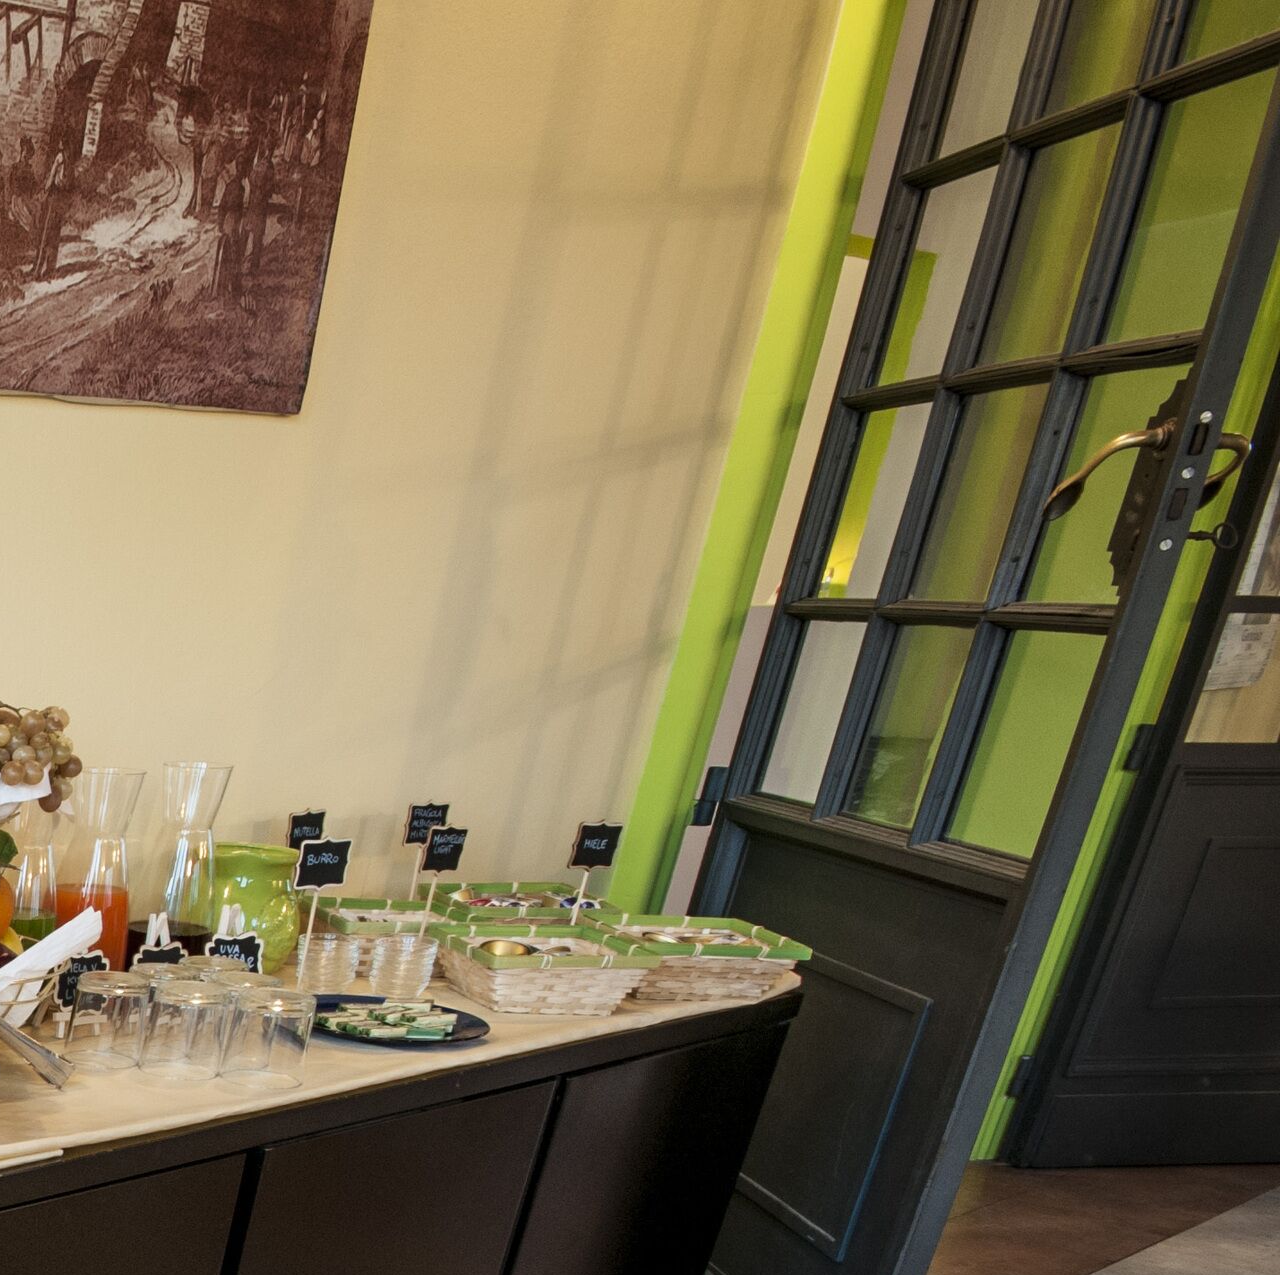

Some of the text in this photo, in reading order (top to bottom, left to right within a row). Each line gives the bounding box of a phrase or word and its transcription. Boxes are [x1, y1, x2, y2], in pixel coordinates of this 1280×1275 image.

[583, 838, 609, 850] MIELE
[306, 852, 340, 866] BURRO
[219, 944, 241, 955] UVA
